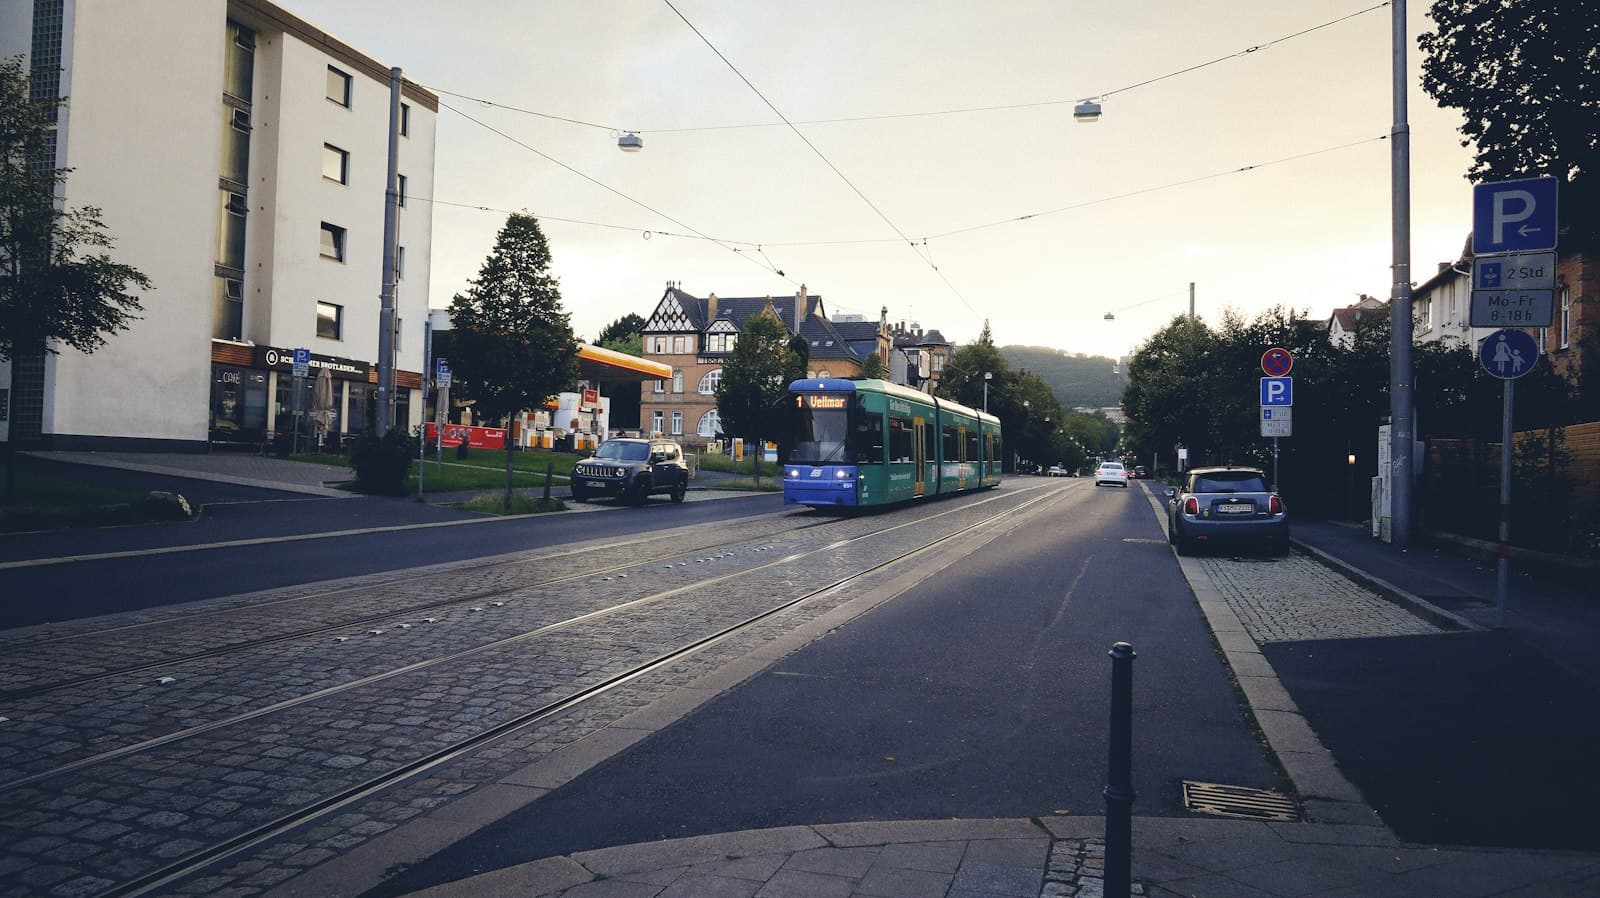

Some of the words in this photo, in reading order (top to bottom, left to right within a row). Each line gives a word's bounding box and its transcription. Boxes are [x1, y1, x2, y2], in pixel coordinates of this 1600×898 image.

[1492, 190, 1536, 244] P
[1507, 268, 1515, 280] 2
[1268, 381, 1285, 402] P
[796, 396, 803, 408] 1
[811, 396, 845, 408] Vellmar
